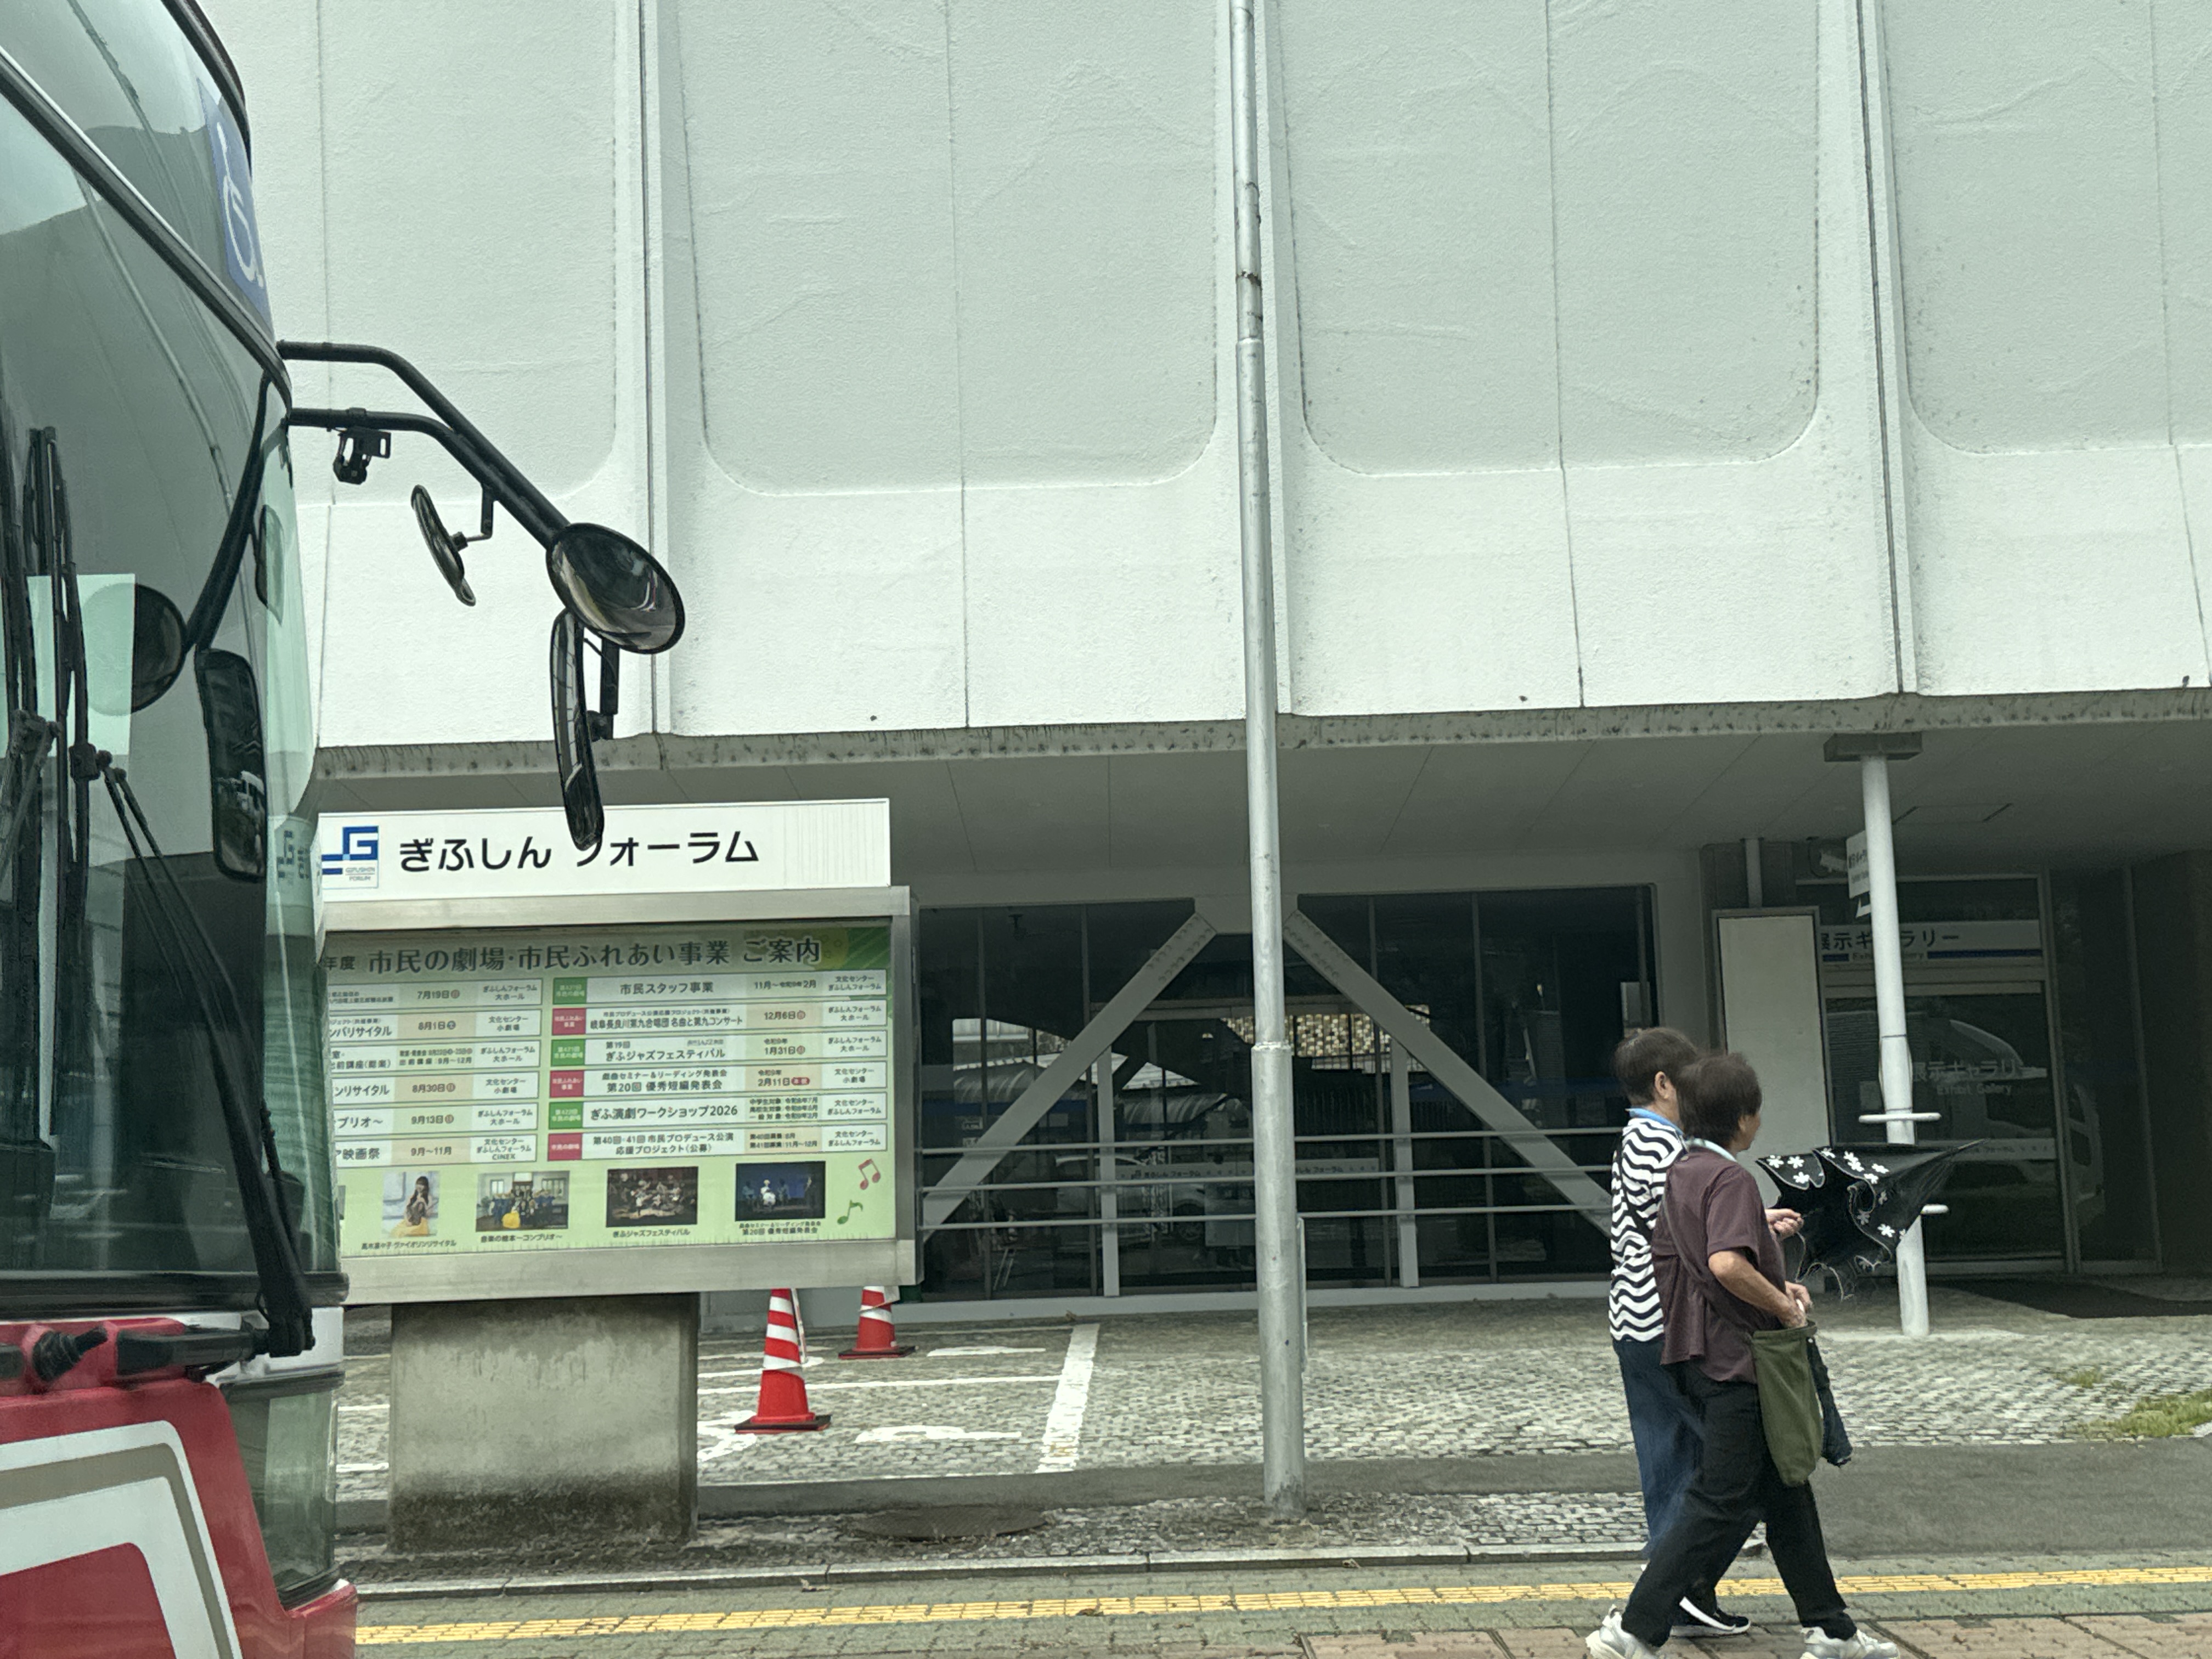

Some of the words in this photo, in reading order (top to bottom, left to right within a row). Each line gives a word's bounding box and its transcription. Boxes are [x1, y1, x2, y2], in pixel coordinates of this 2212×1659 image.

[399, 836, 551, 872] ぎふしん
[1821, 928, 1959, 951] 示ギラリー
[743, 937, 821, 963] ご案内
[620, 981, 714, 995] 市民スタッフ事業
[488, 1015, 529, 1024] 文化センター
[606, 1047, 726, 1062] ぎふジャズフェスティバル
[591, 1105, 738, 1120] ぎふ演劇ワークショップ2026
